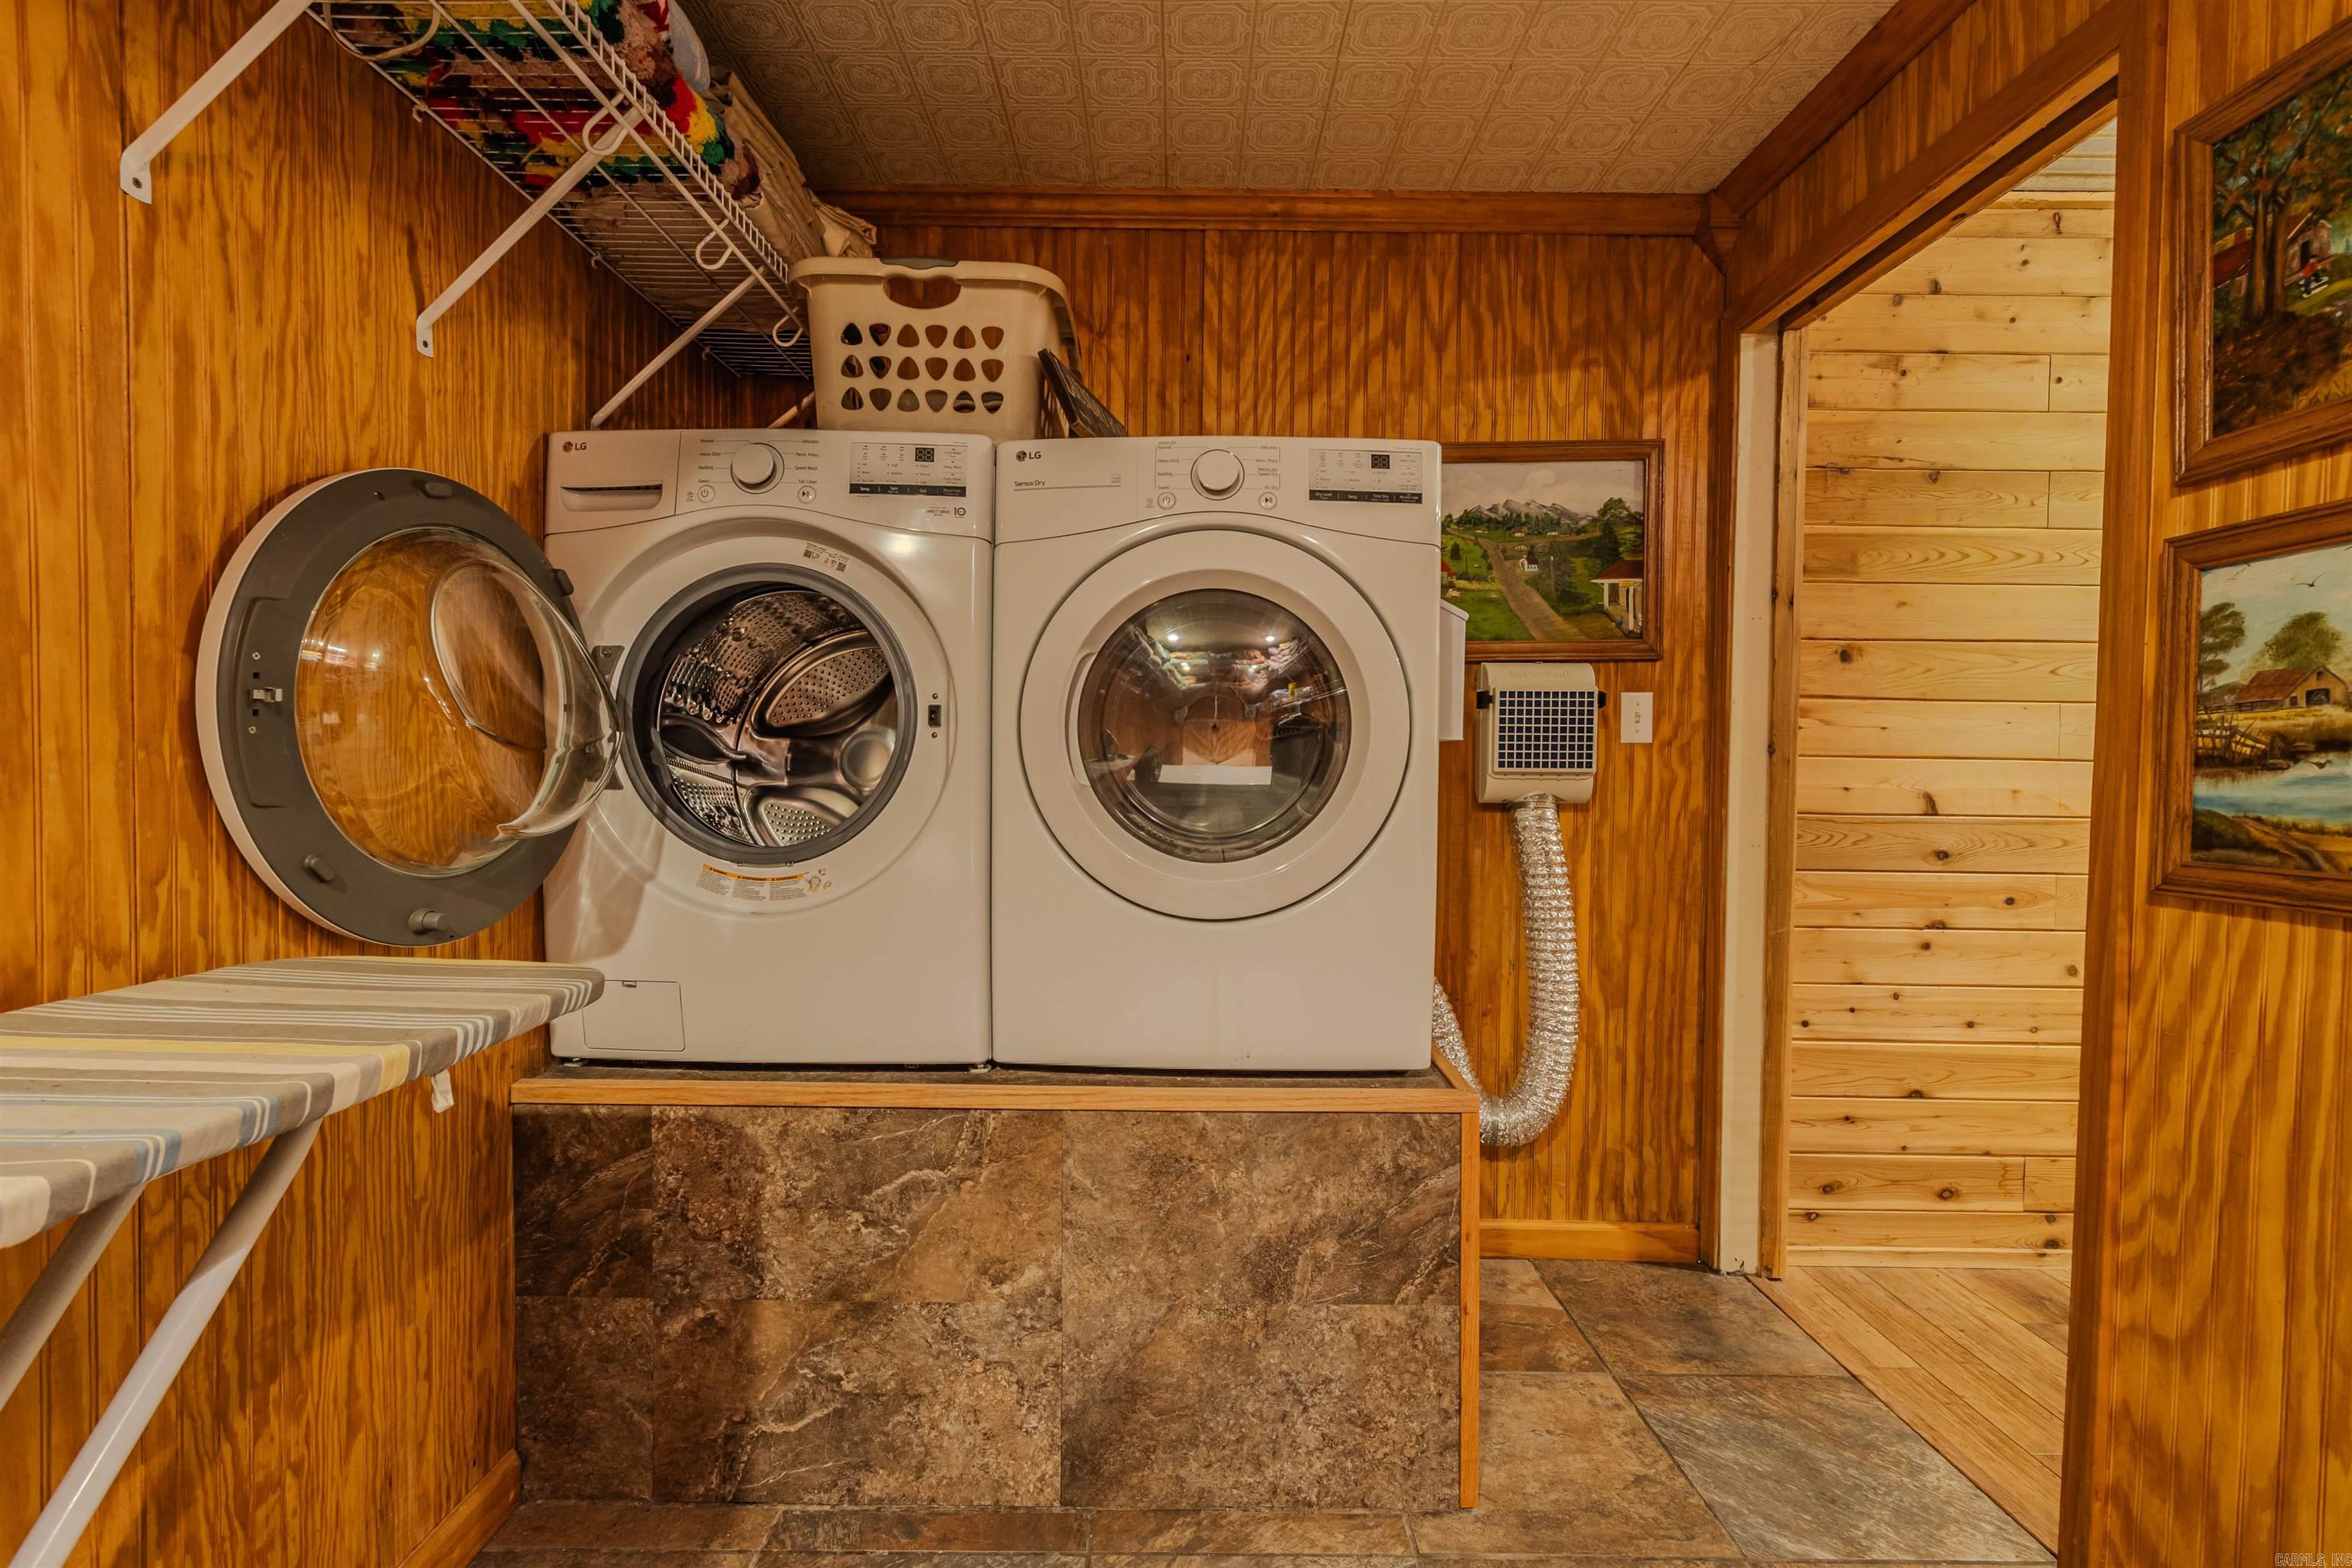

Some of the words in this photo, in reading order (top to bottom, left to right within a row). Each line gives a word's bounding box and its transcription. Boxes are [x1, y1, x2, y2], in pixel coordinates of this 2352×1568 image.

[574, 442, 587, 451] LG
[1028, 451, 1041, 459] LG
[1034, 479, 1046, 488] Dry
